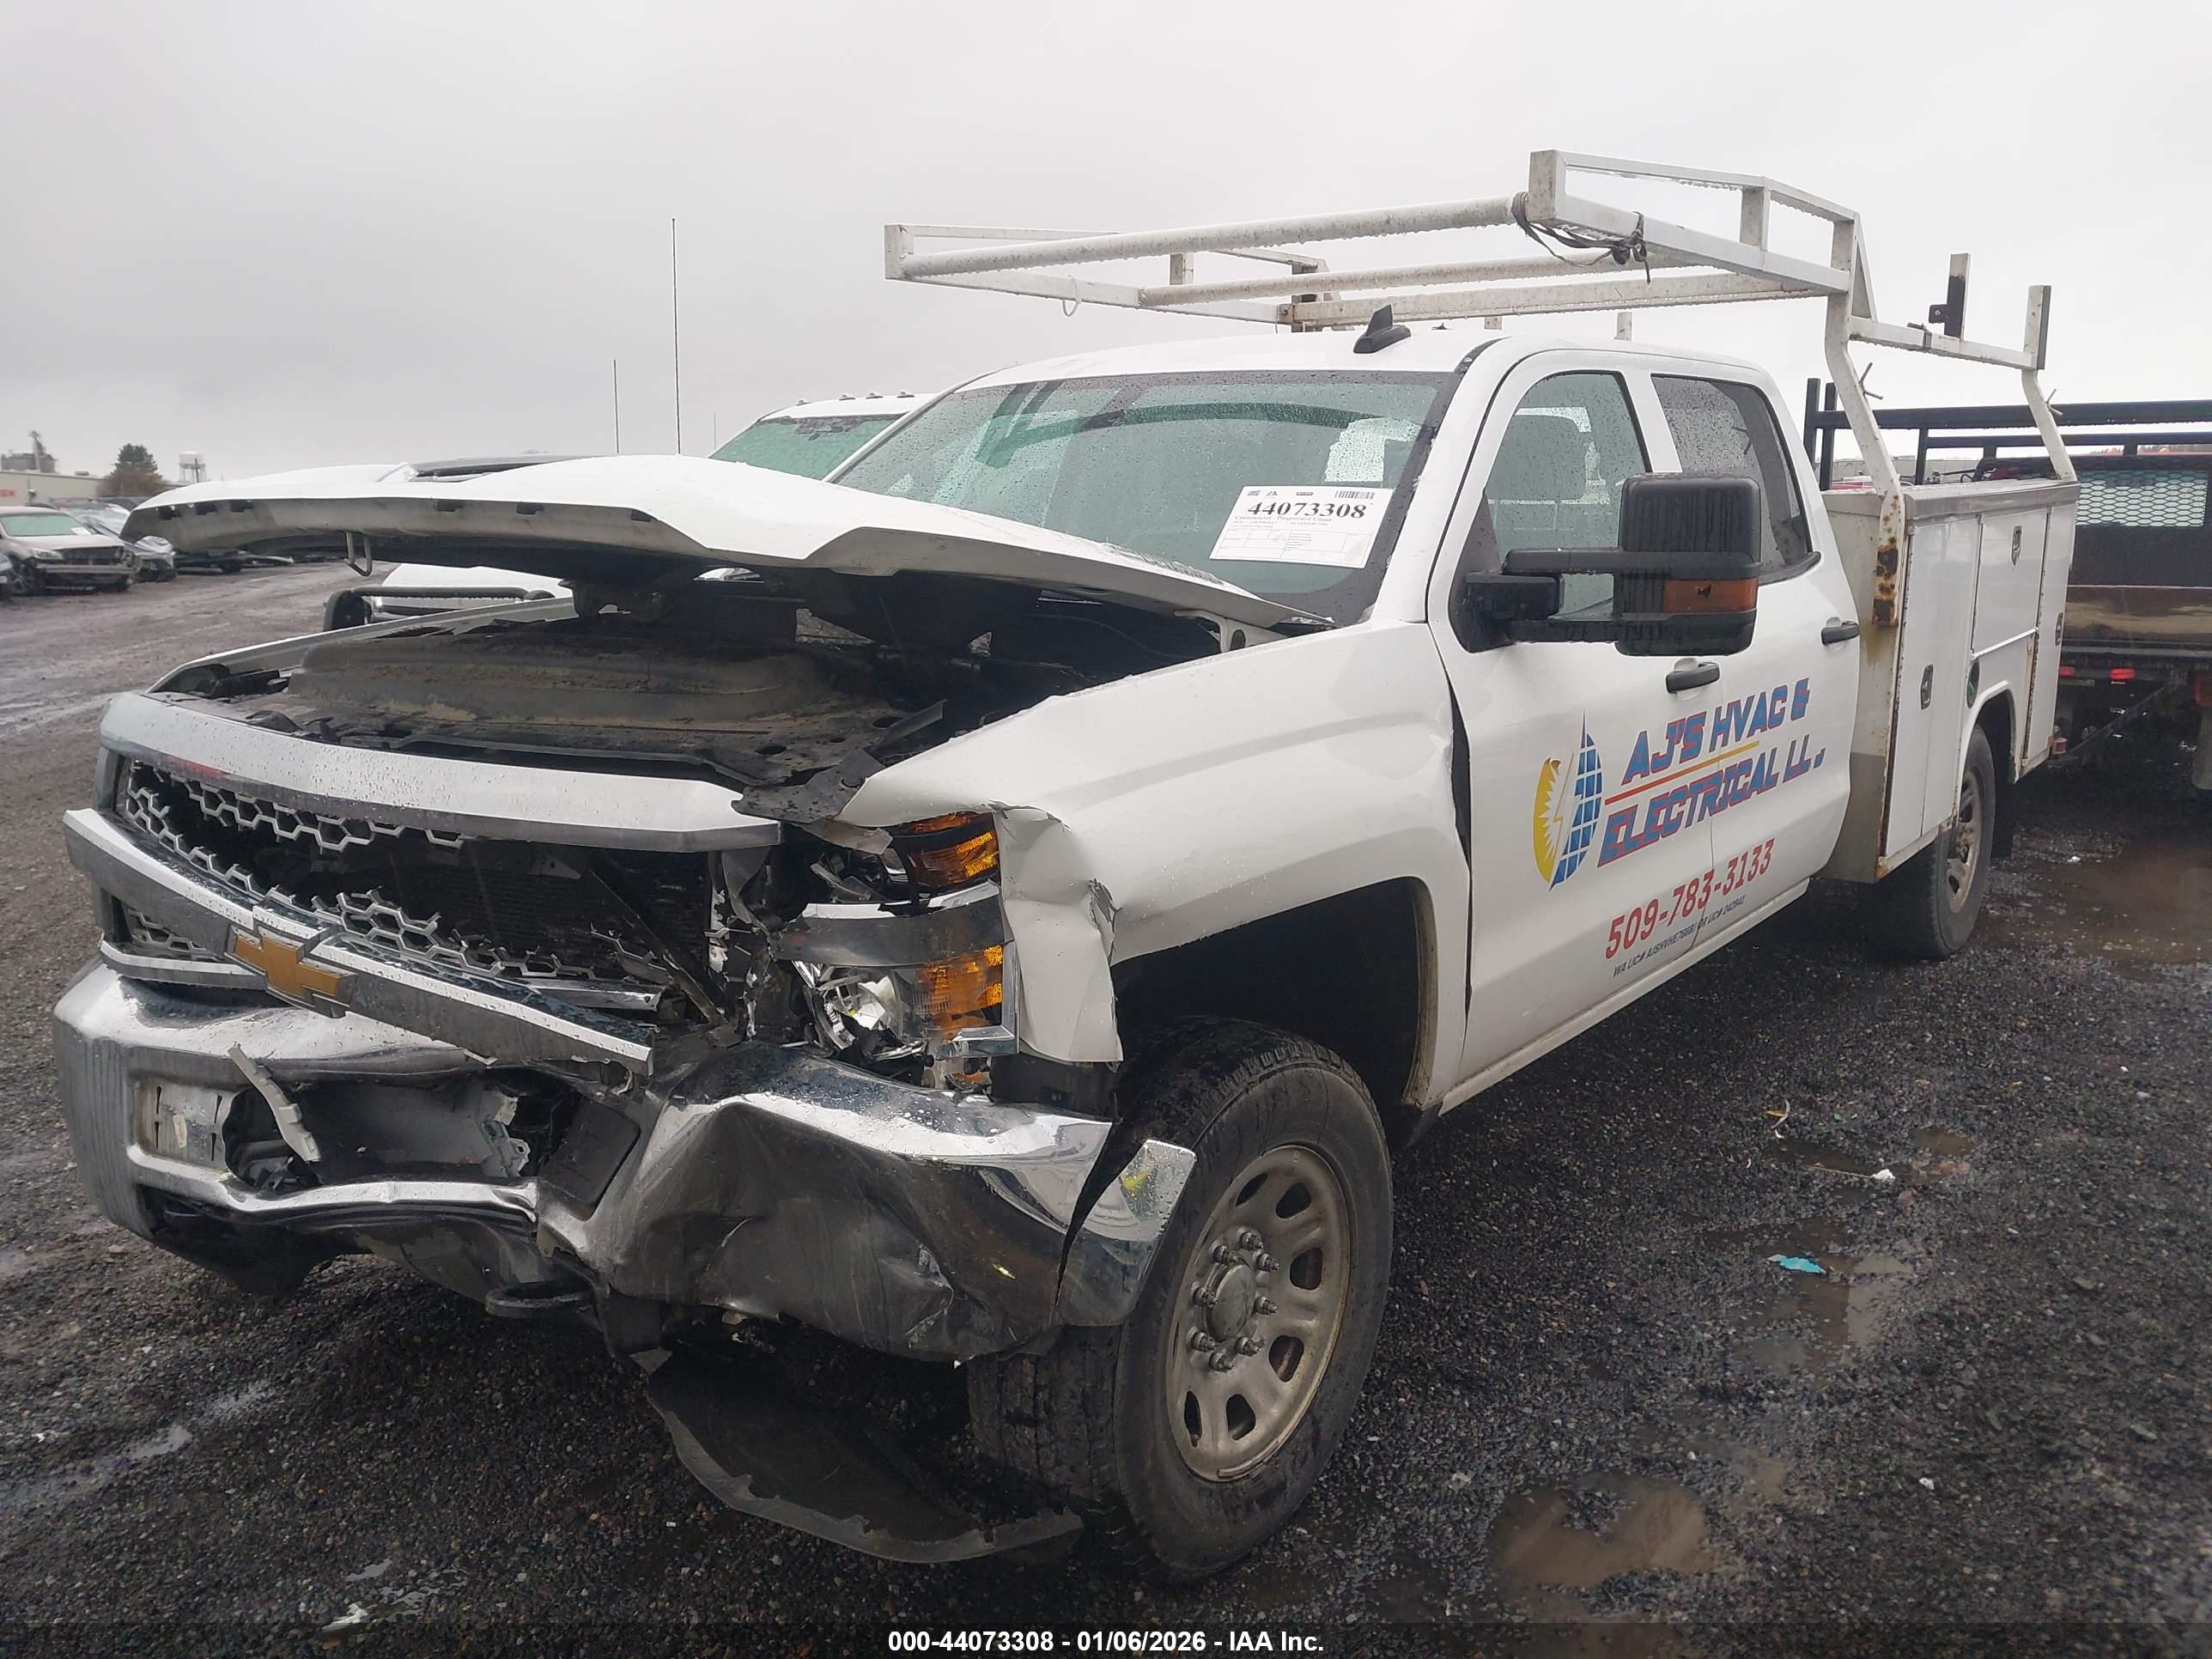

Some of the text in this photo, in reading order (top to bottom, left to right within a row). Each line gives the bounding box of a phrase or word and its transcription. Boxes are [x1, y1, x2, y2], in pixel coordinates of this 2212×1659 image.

[1247, 501, 1367, 519] 44073308
[1620, 678, 1810, 786] AJ'S HVAC &
[1597, 747, 1779, 868] ELECTRICAL
[1605, 838, 1775, 960] 509-783-3133
